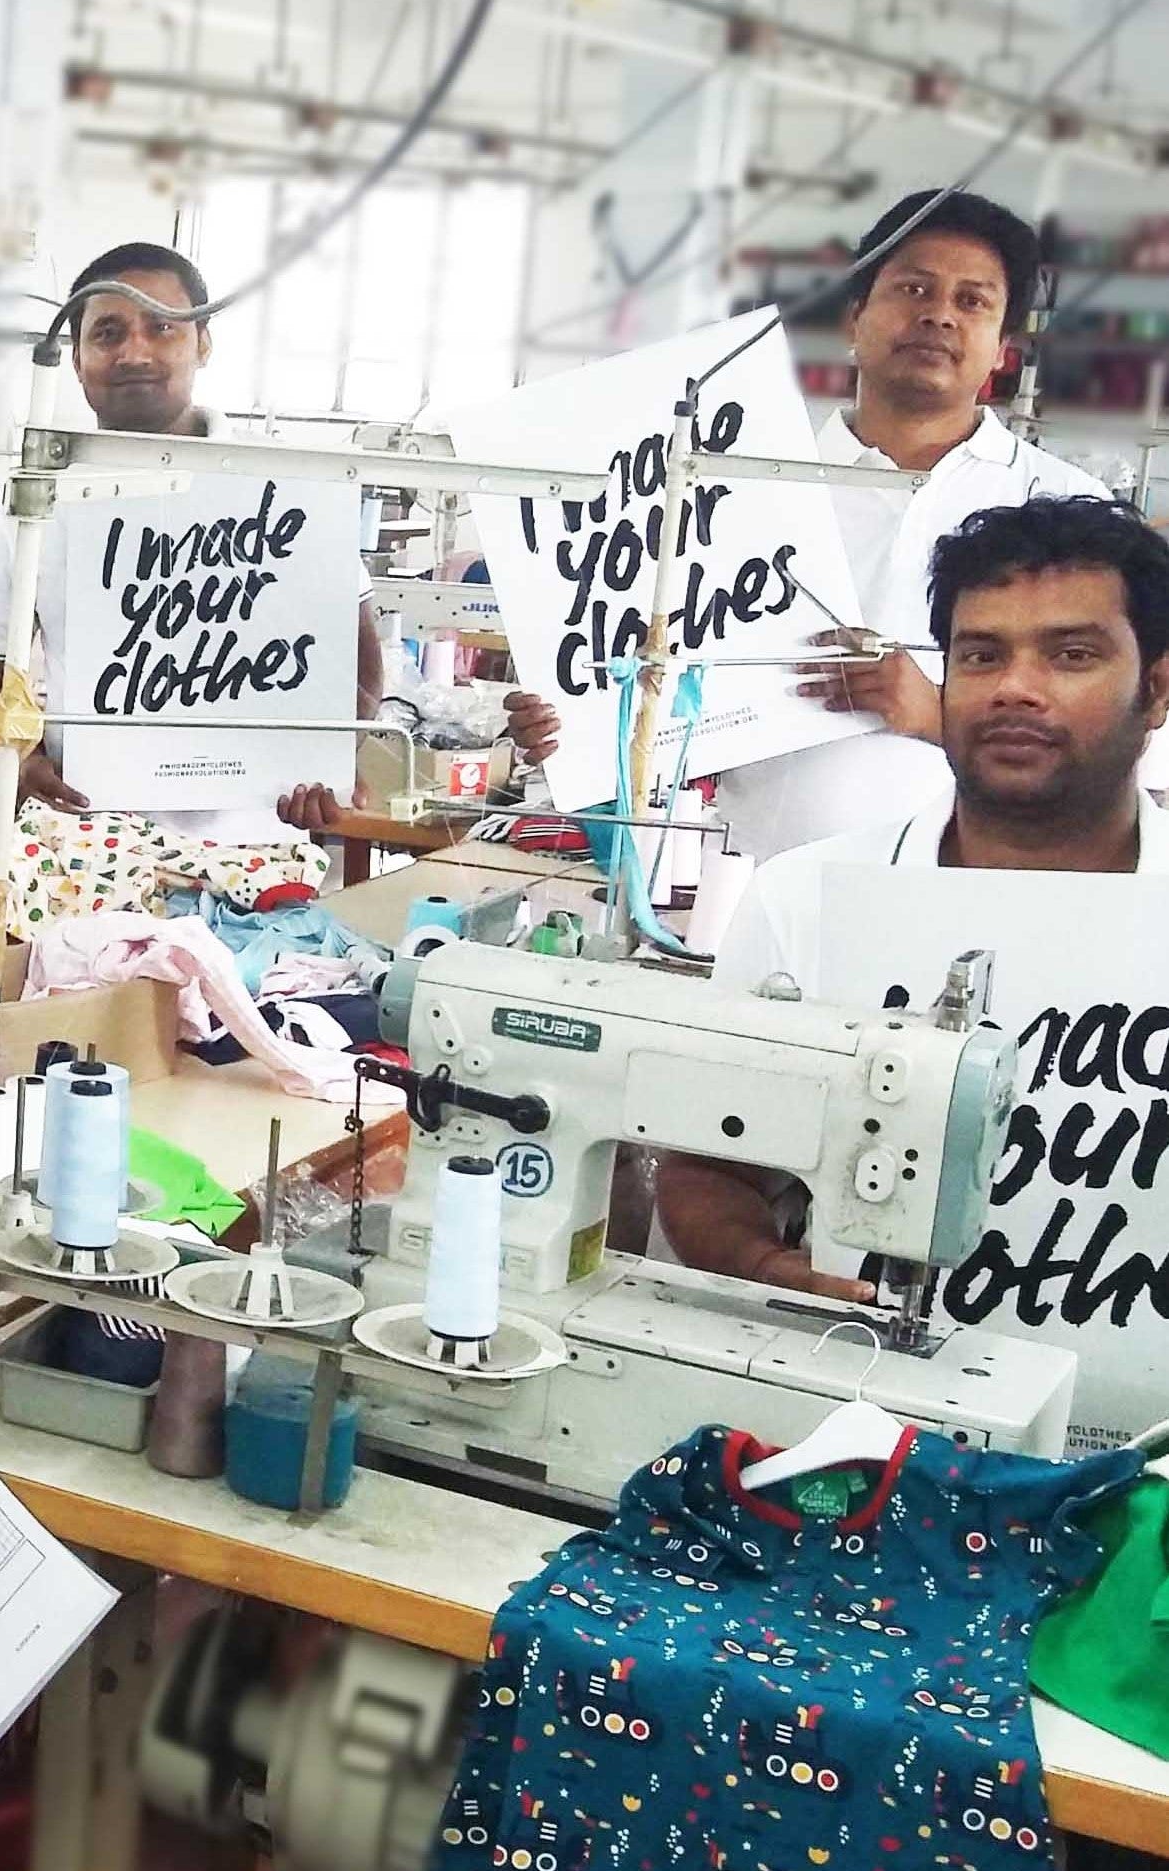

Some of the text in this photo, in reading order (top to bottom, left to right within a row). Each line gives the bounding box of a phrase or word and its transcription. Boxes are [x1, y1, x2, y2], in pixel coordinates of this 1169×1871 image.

[102, 480, 307, 589] I made
[113, 569, 278, 658] your
[94, 630, 315, 715] clothes
[505, 1152, 544, 1188] 15
